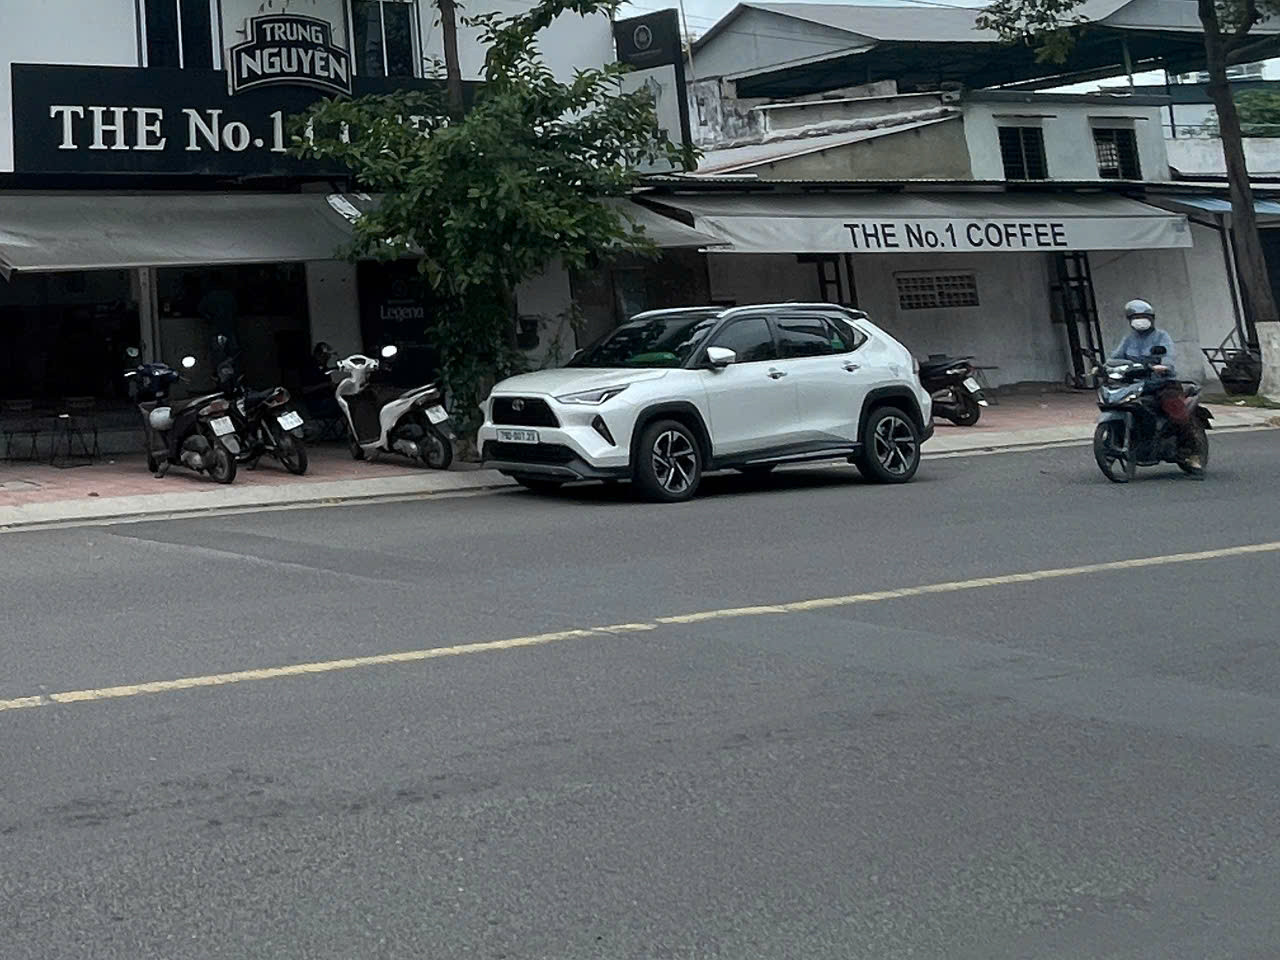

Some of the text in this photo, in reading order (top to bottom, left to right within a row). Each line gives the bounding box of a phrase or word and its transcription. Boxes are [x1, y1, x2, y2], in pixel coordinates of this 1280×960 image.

[262, 23, 324, 43] TRUNG
[241, 46, 347, 82] NGUYÊN
[49, 106, 167, 151] THE
[182, 109, 287, 153] No.1
[843, 223, 1068, 249] THE No.1 COFFEE
